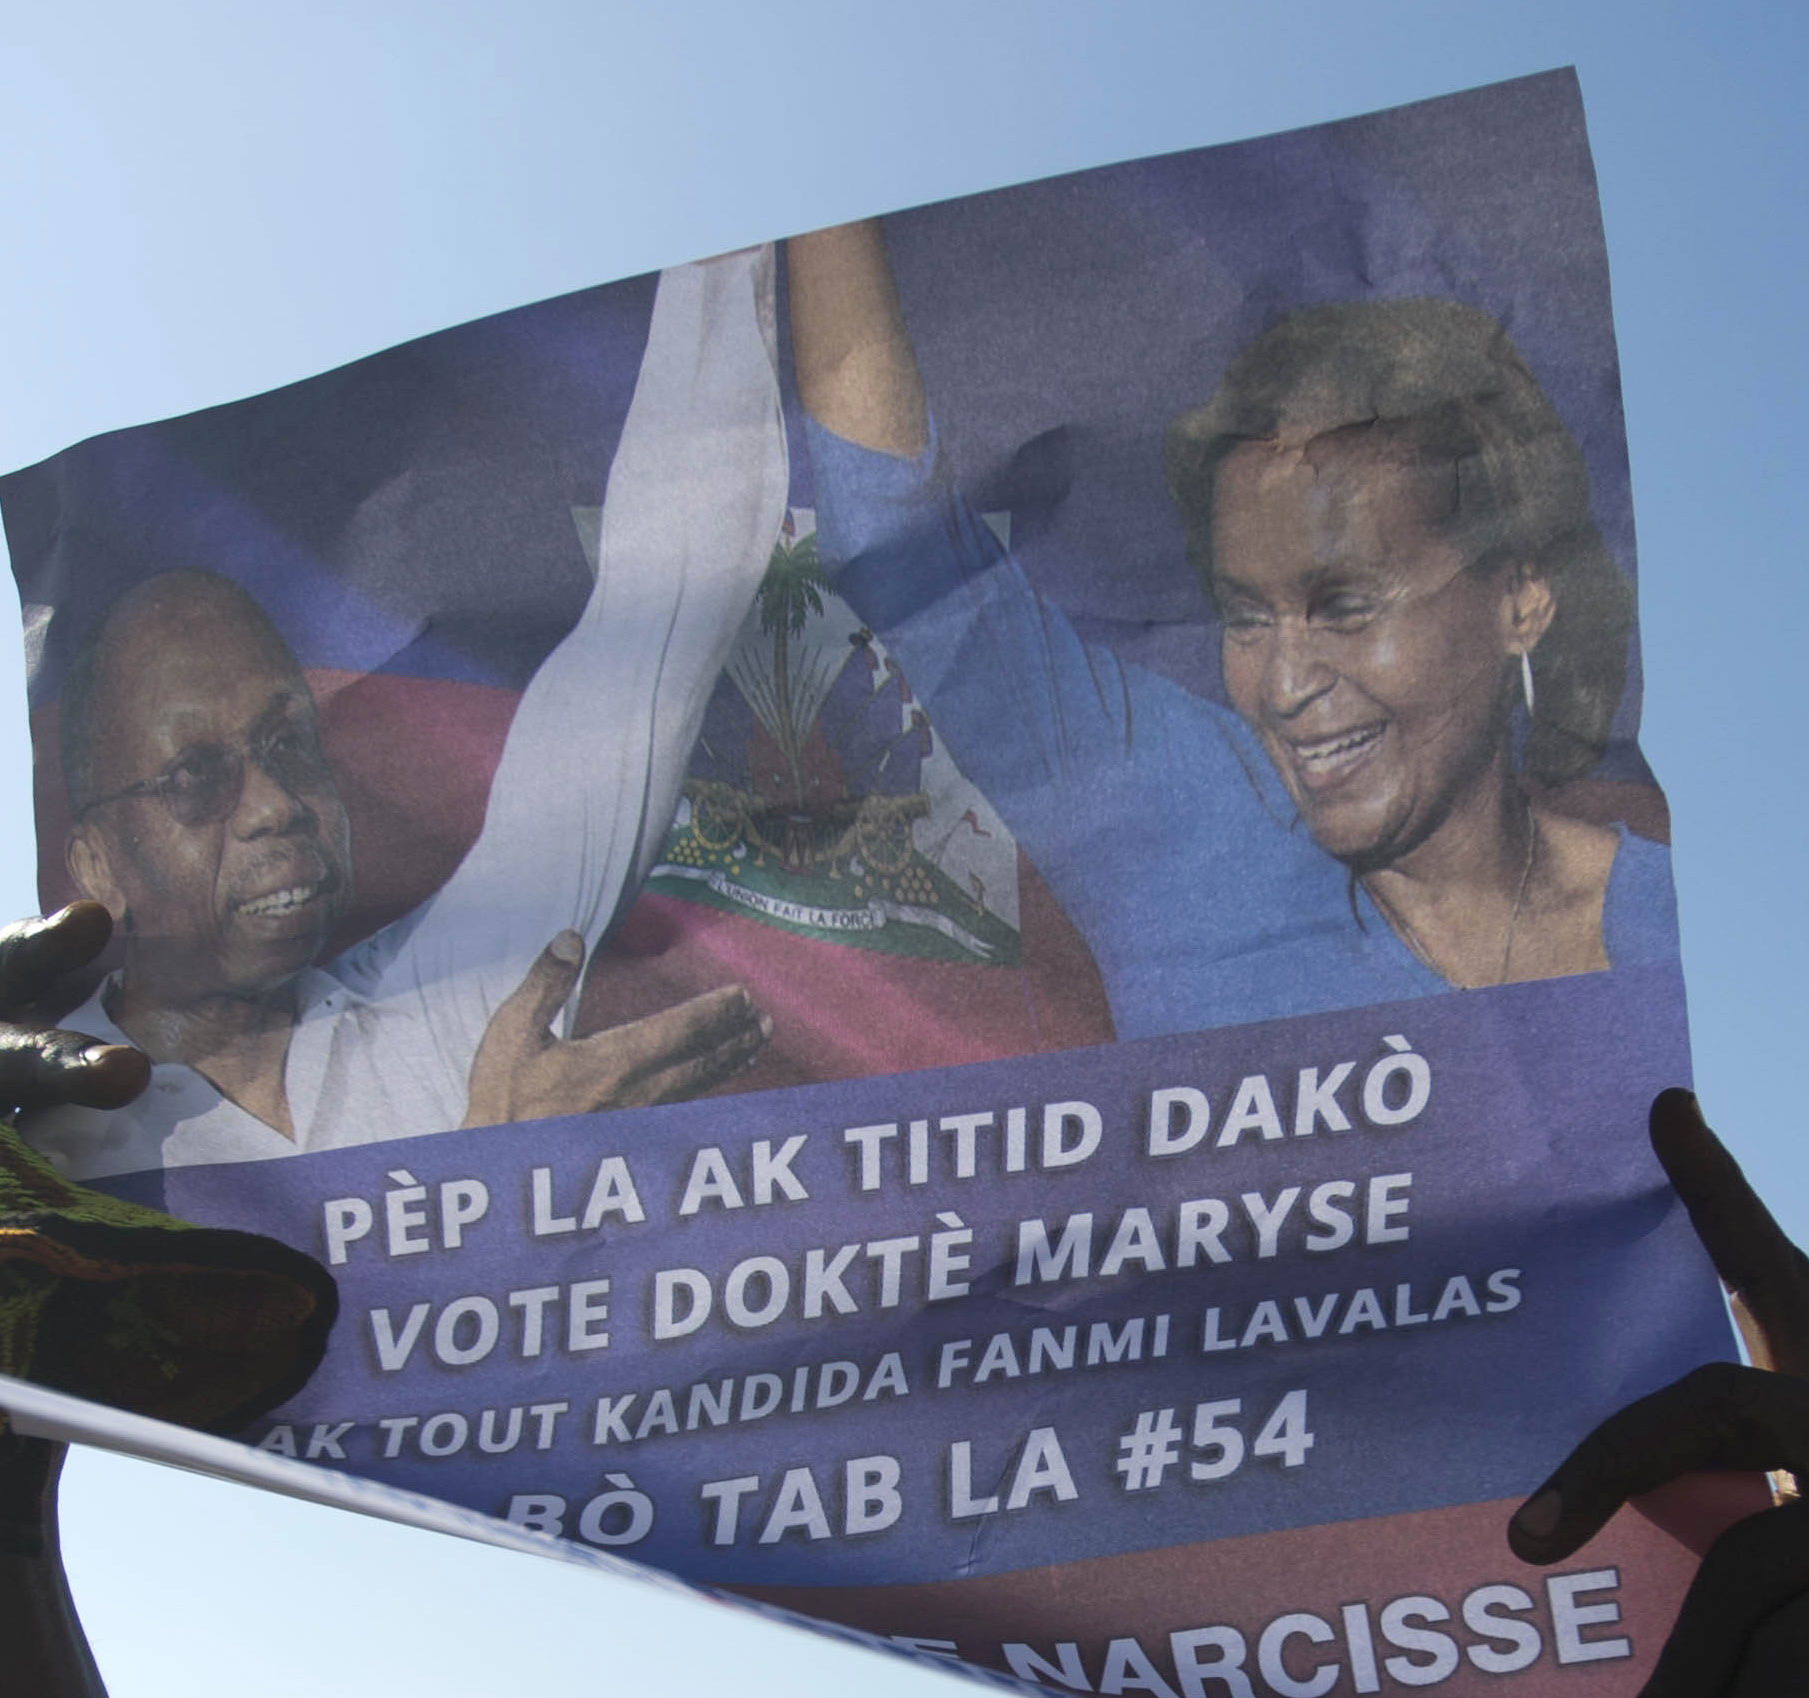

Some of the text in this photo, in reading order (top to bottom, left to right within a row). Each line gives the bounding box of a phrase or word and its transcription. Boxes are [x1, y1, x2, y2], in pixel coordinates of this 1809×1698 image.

[324, 1034, 1434, 1265] PÈP LA AK TITID DAKÒ
[257, 1267, 1523, 1460] AK TOUT KANDIDA FANMI LAVALAS
[369, 1172, 1413, 1371] VOTE DOKTÈ MARYSE
[506, 1389, 1315, 1546] BÒ TAB LA #54
